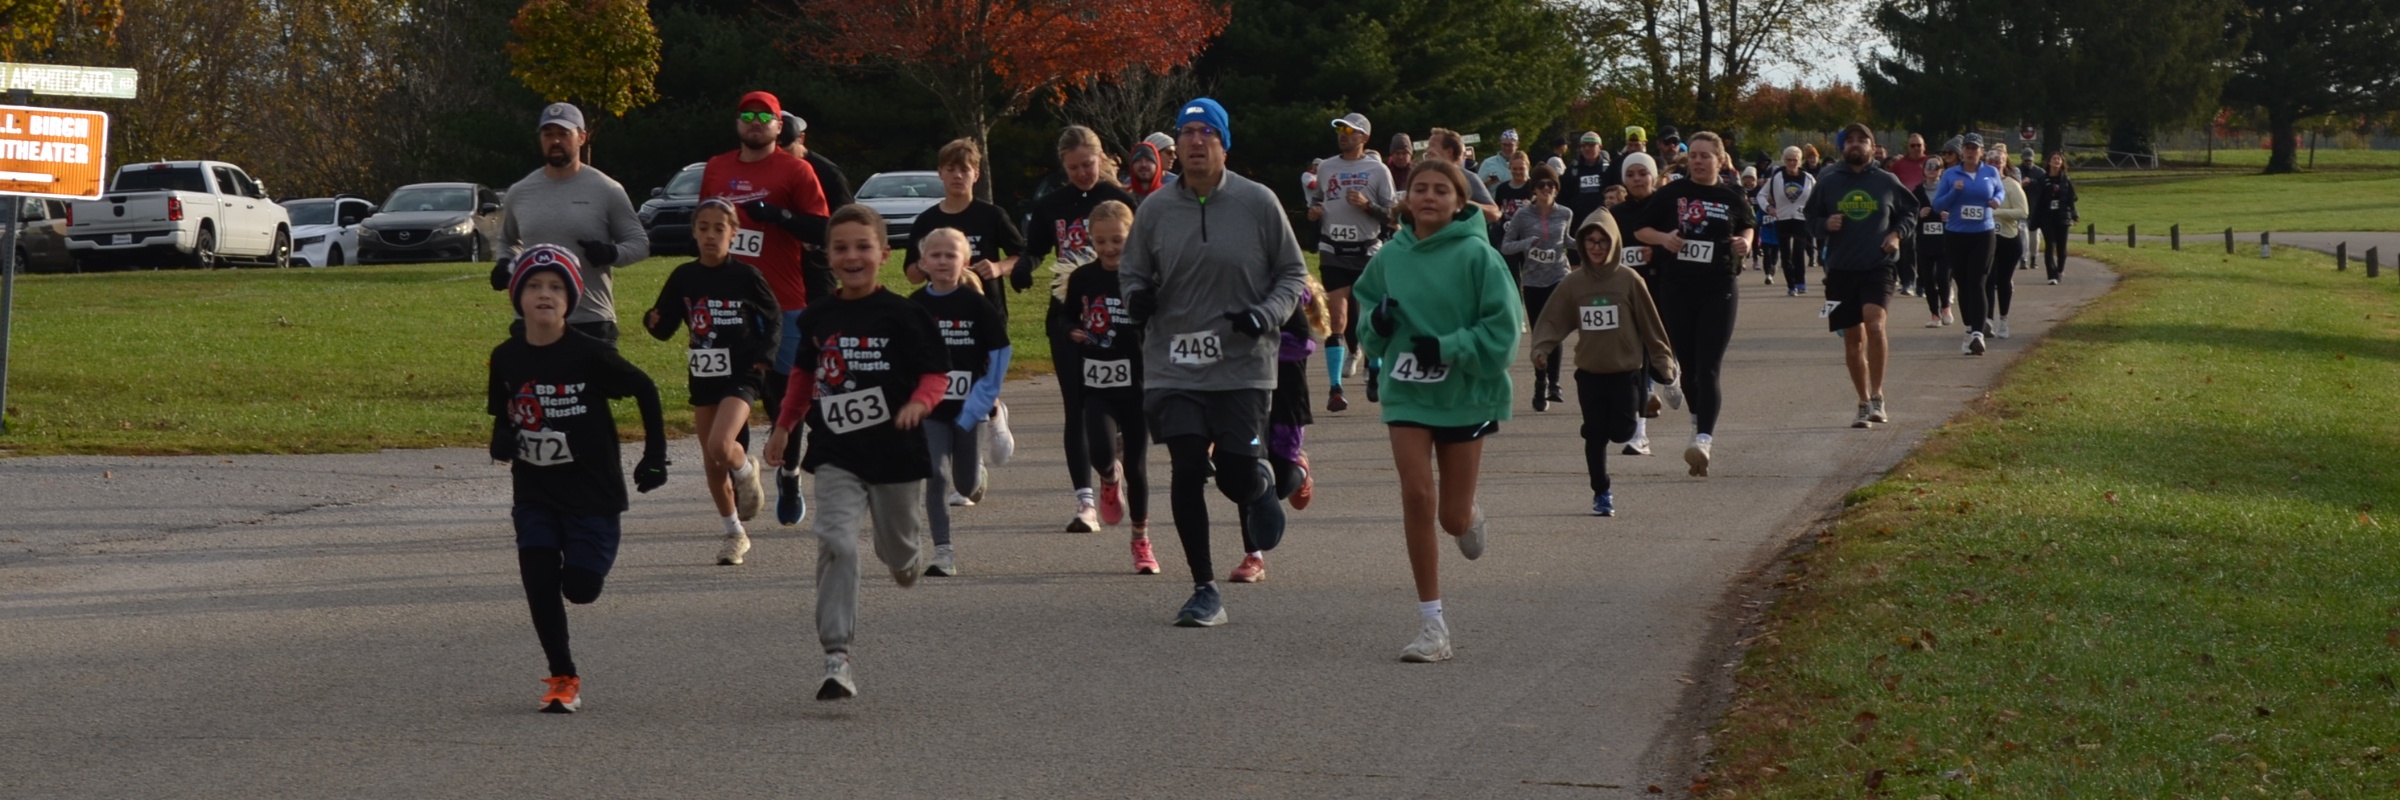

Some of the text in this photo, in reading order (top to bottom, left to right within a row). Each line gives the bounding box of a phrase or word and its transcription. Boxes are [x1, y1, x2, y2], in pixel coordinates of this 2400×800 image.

[10, 67, 113, 93] AMPHITHEATER
[119, 77, 134, 90] RD
[29, 115, 89, 138] BIRCH
[1962, 207, 1983, 218] 485
[1331, 227, 1357, 240] 445
[1924, 223, 1942, 233] 454
[729, 232, 760, 253] 16
[1530, 249, 1555, 261] 404
[1680, 242, 1712, 260] 407
[710, 308, 738, 316] Hemo
[1582, 309, 1617, 327] 481
[713, 317, 743, 325] Hustle
[941, 328, 970, 337] Hemo
[945, 337, 976, 346] Hustle
[1174, 336, 1218, 360] 448
[843, 349, 882, 360] Hemo
[690, 353, 728, 373] 423
[848, 360, 891, 371] Hustle
[1086, 364, 1129, 385] 428
[540, 396, 579, 407] Hemo
[545, 405, 588, 418] Hustle
[827, 394, 884, 428] 463
[519, 434, 569, 461] 472
